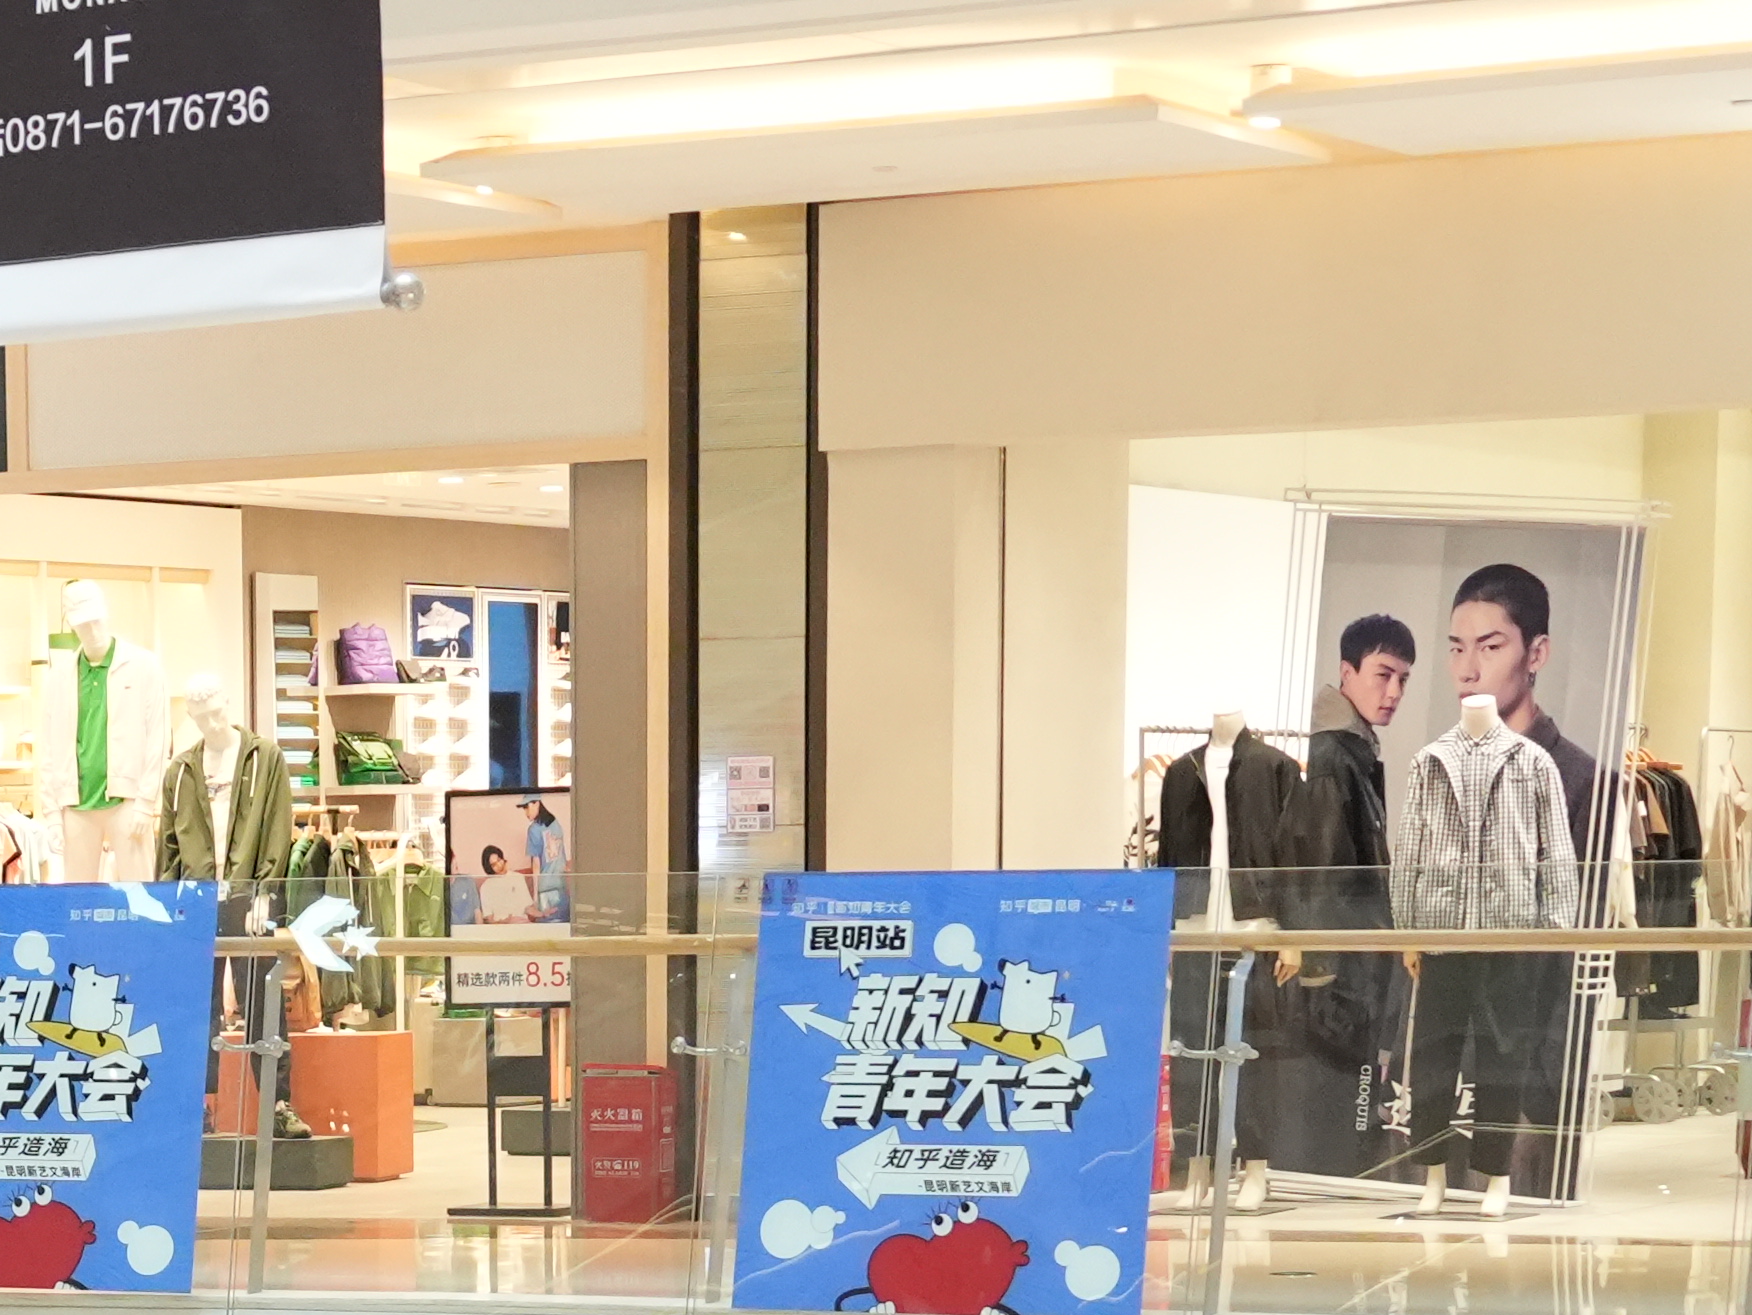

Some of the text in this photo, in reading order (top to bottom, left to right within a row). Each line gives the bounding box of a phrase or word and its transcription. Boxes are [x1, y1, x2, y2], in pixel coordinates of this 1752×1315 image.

[73, 34, 131, 87] 1F
[810, 925, 907, 951] 昆明站
[840, 973, 983, 1050] 新知
[821, 1053, 1086, 1132] 青年大会
[1355, 1064, 1373, 1131] CROQUIS
